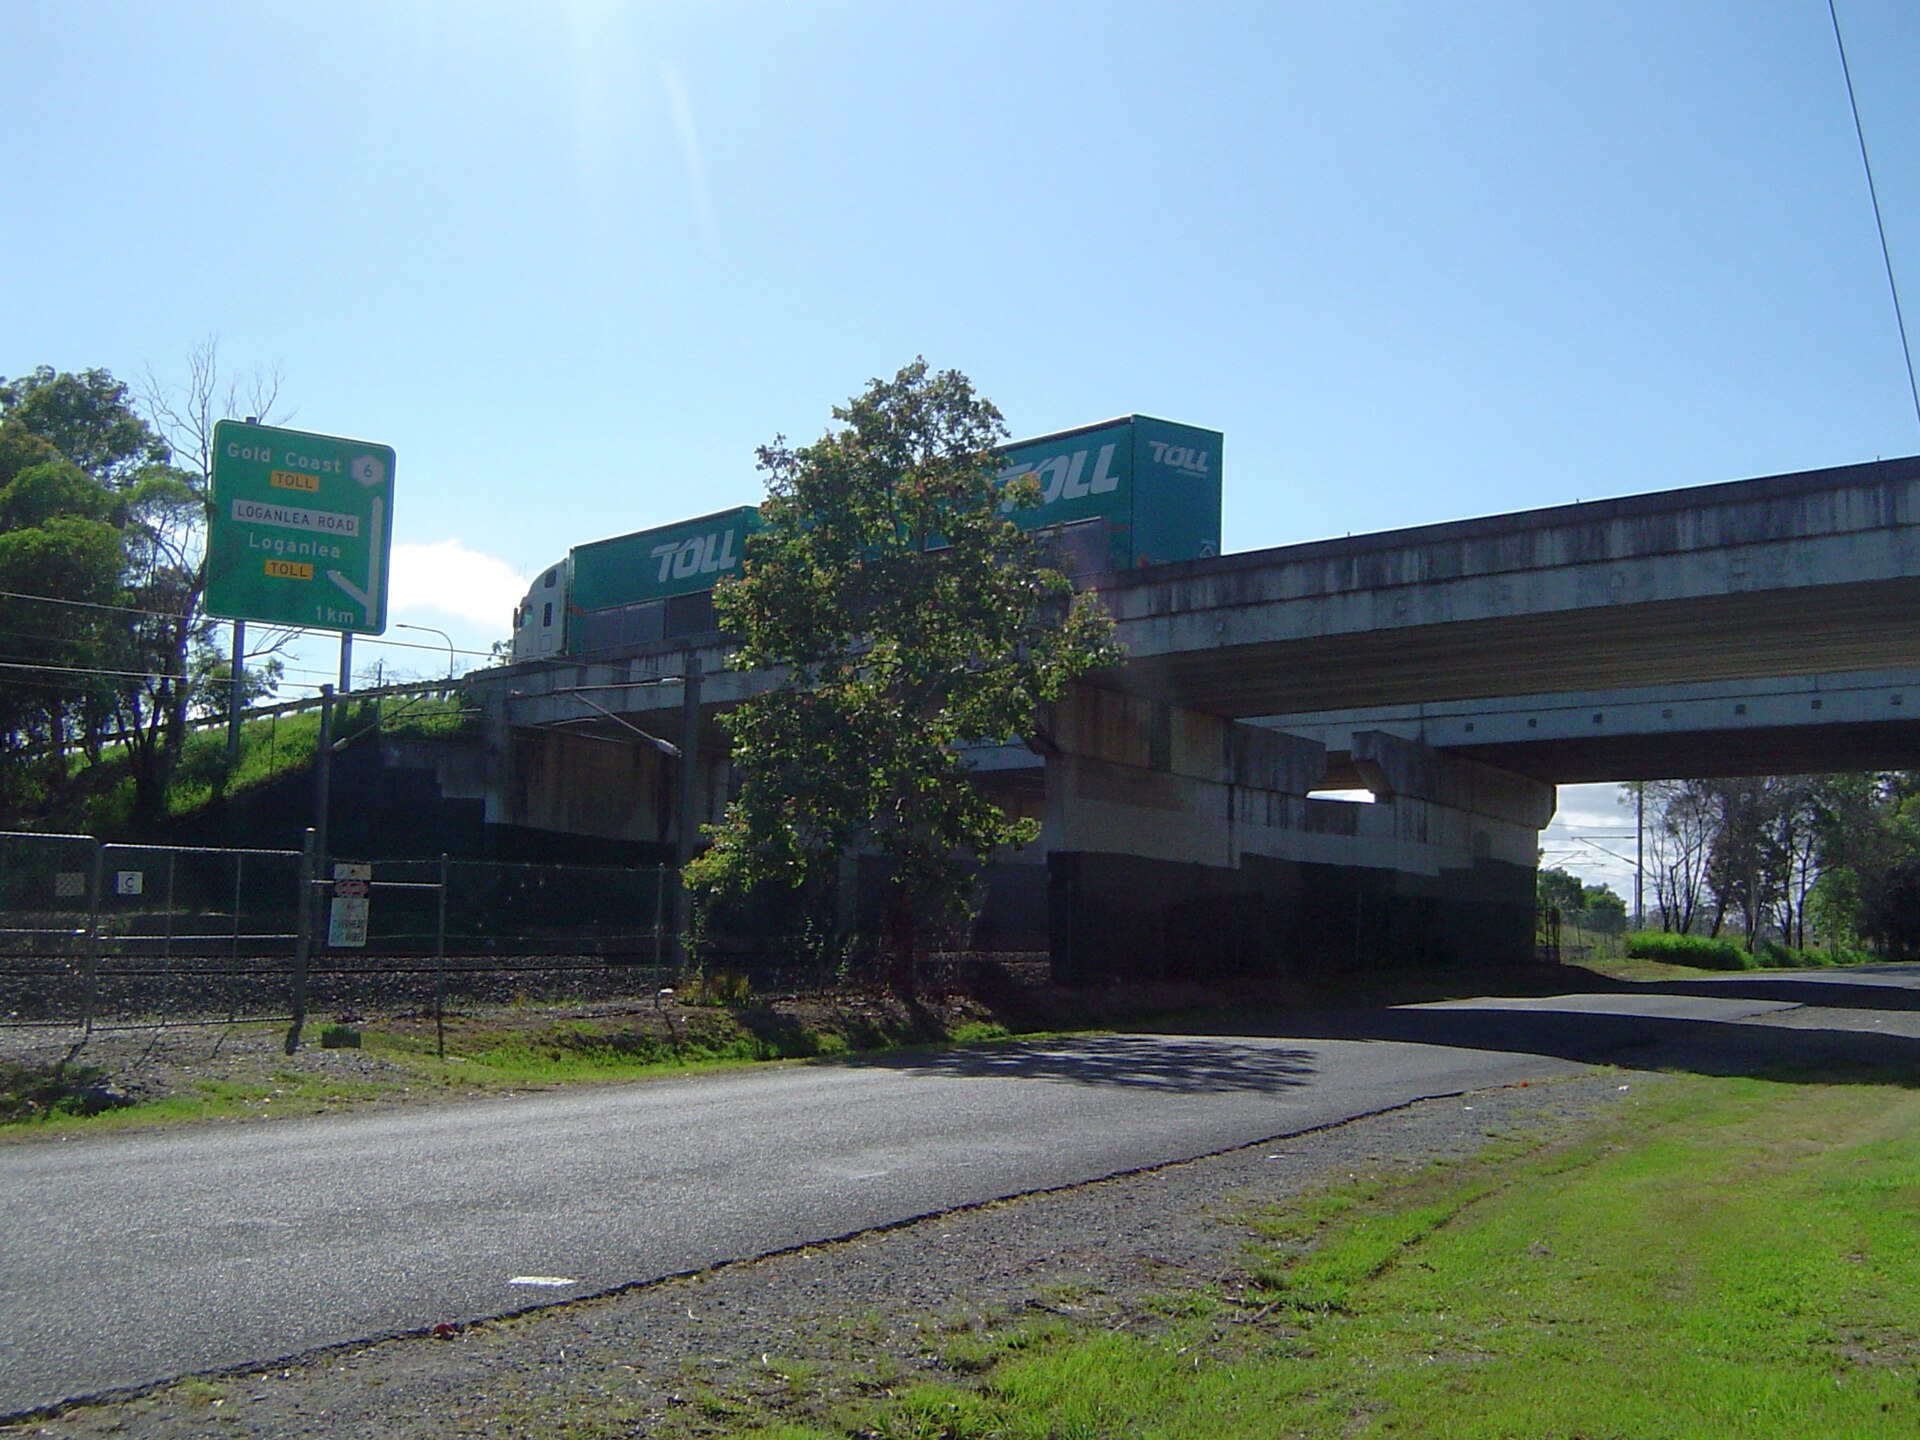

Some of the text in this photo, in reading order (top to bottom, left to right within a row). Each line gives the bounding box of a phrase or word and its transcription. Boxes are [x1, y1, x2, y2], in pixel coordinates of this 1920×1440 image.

[227, 443, 342, 472] Gold Coast
[1150, 441, 1208, 472] TOLL
[276, 473, 313, 489] TOLL
[363, 464, 374, 478] 6
[997, 444, 1120, 513] TOLL
[237, 505, 354, 532] LOGANLEA ROAD
[249, 533, 341, 558] Loganlea
[651, 529, 737, 582] TOLL
[271, 562, 308, 578] TOLL
